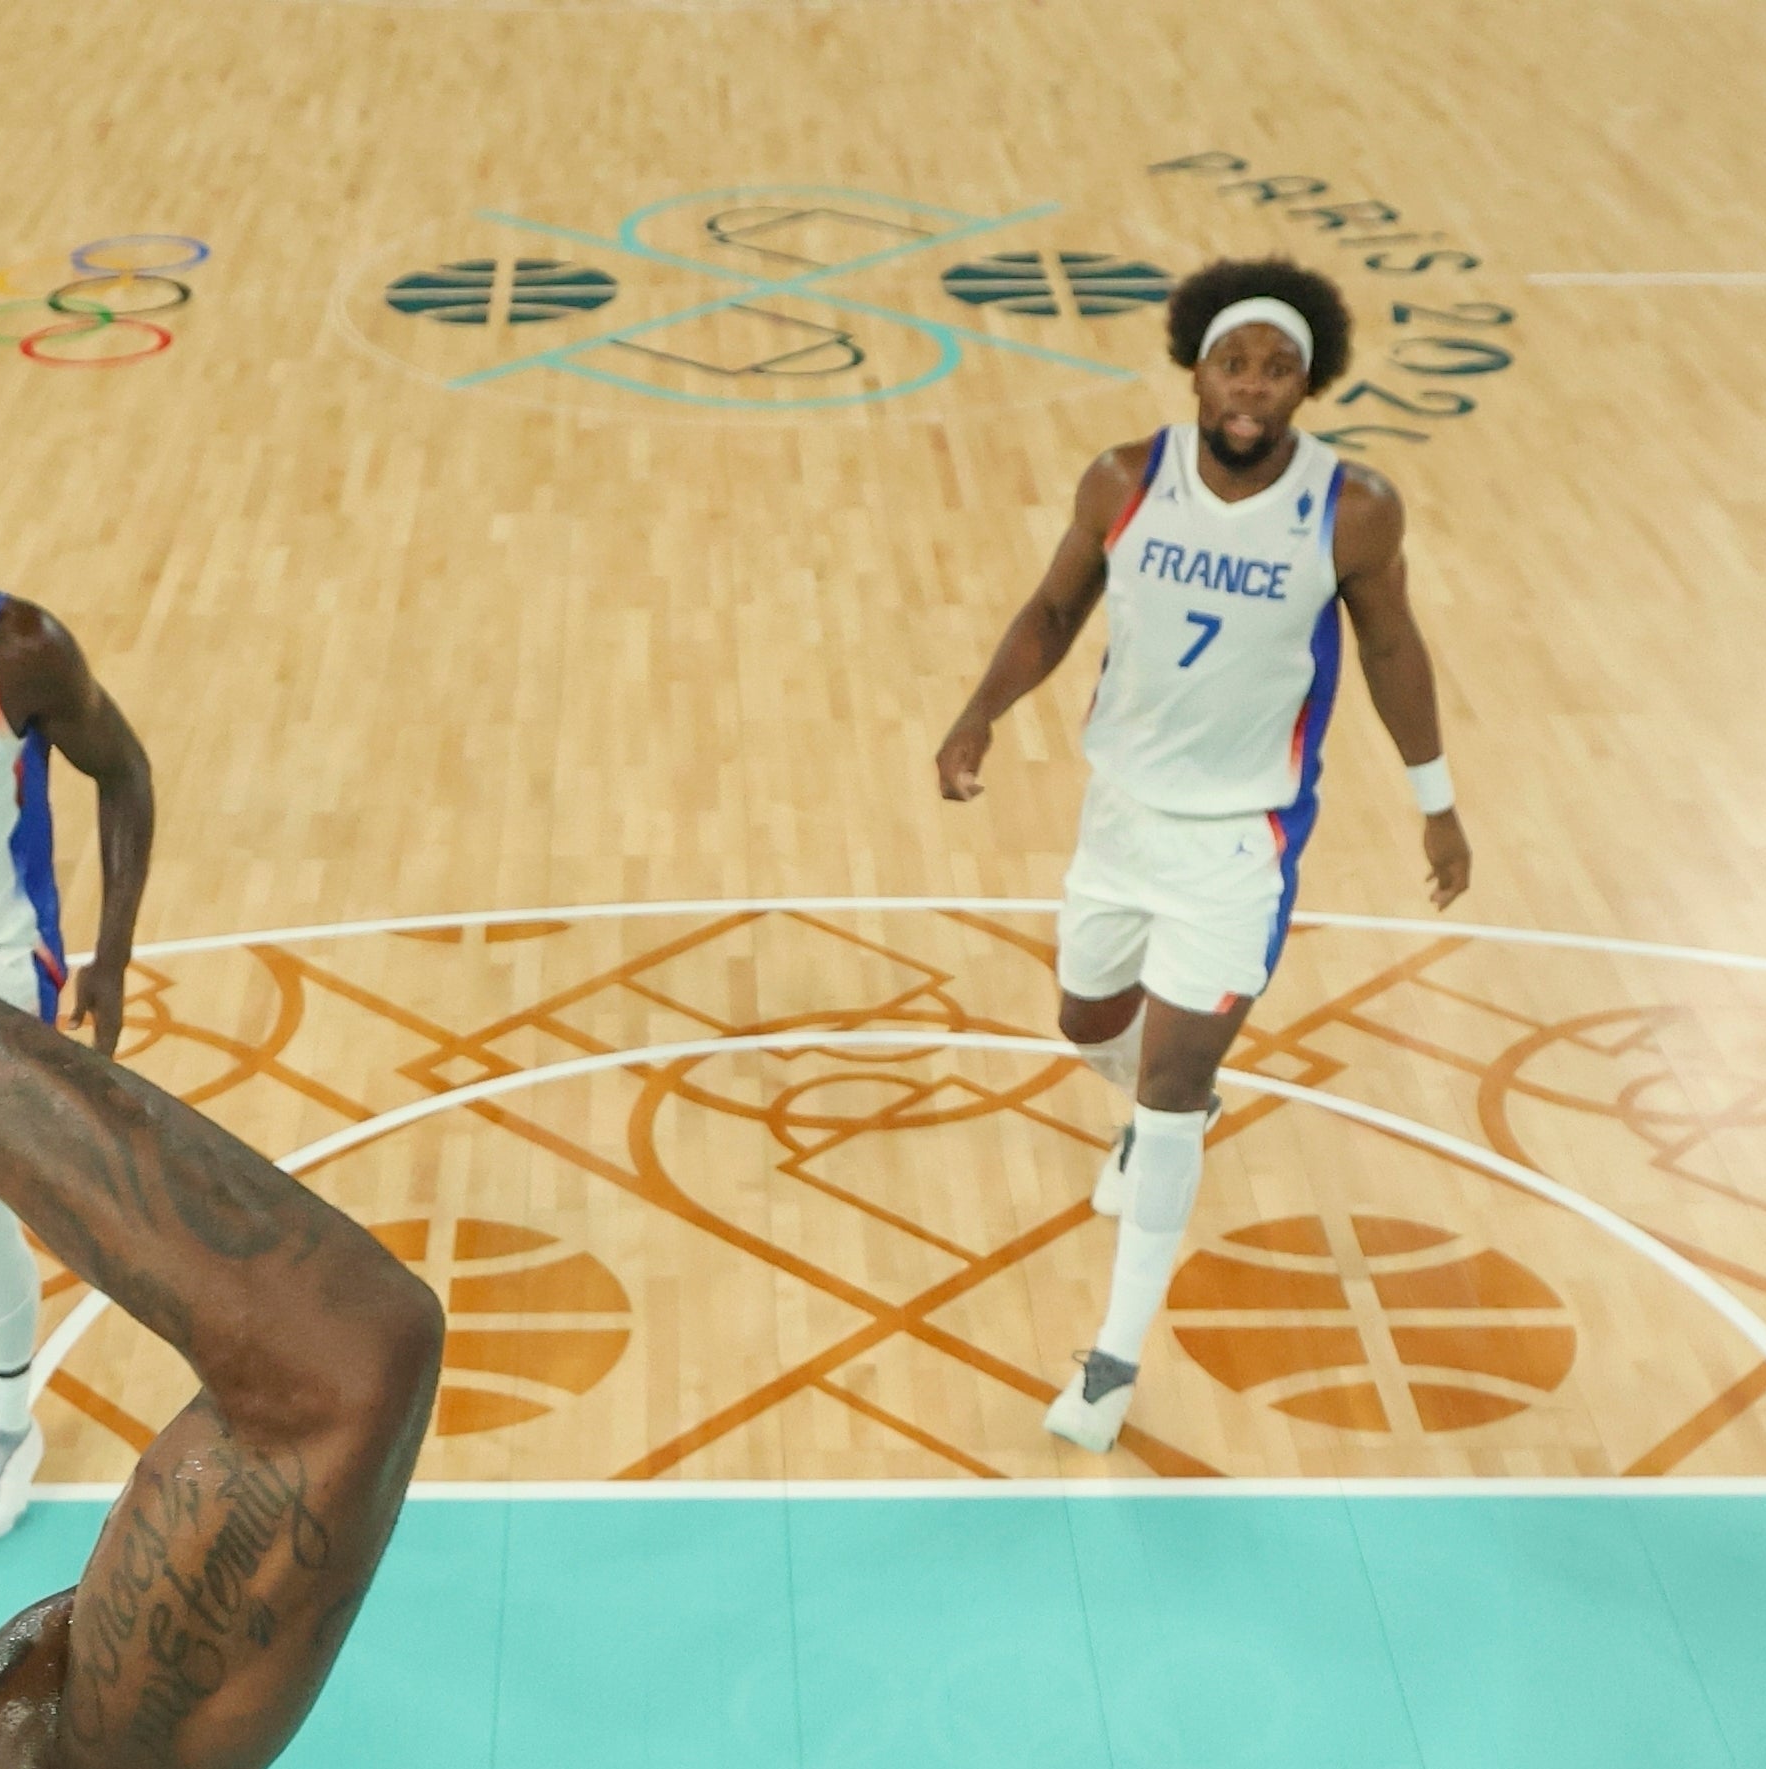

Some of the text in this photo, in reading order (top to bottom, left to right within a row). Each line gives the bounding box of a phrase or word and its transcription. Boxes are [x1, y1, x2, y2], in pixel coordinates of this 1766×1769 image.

[1146, 150, 1479, 273] PARIS
[1139, 537, 1293, 601] FRANCE
[1177, 610, 1223, 669] 7
